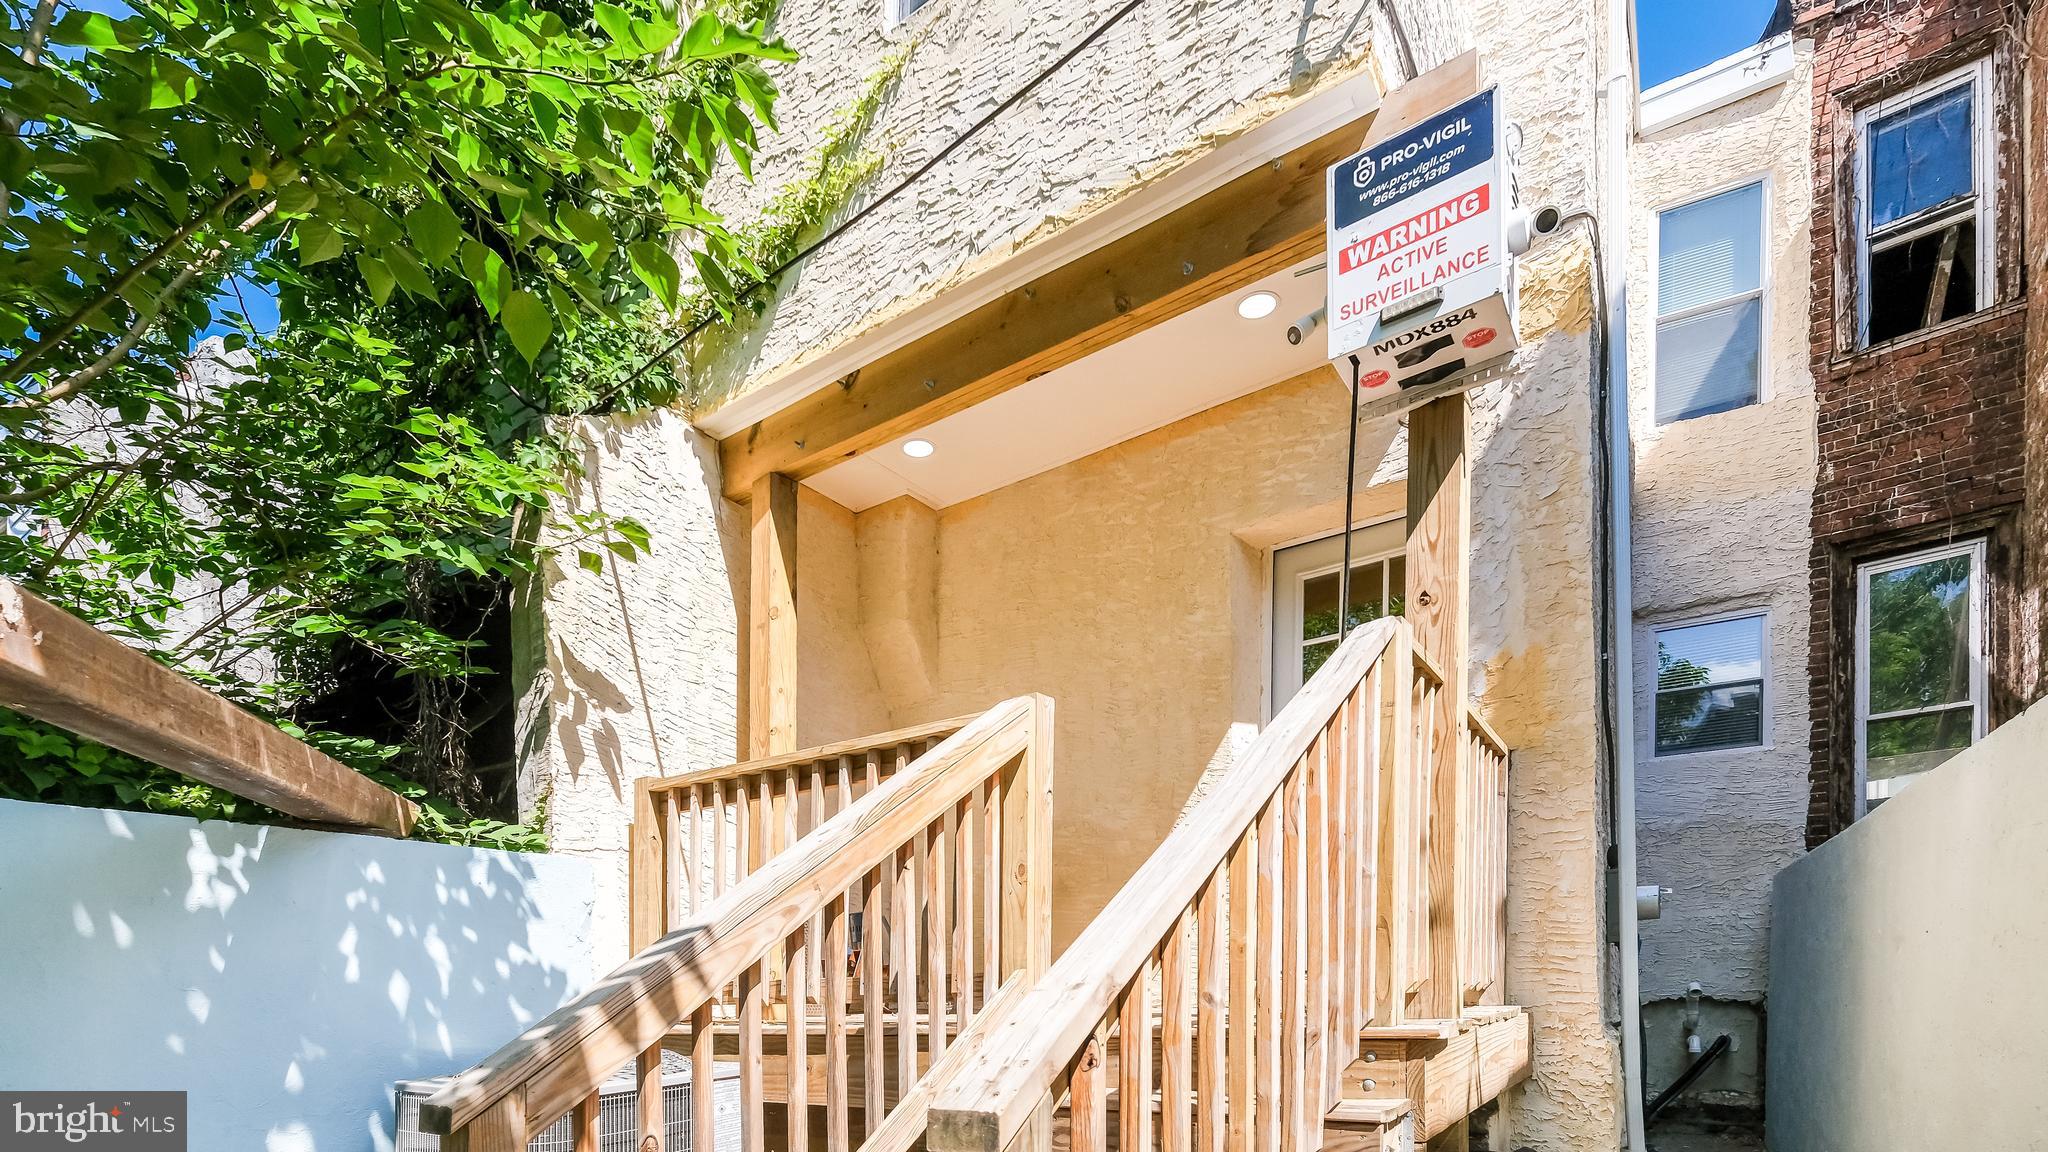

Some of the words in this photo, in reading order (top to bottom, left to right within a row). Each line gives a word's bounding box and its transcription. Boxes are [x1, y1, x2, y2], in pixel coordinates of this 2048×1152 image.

[1381, 117, 1472, 172] PRO-VIGIL
[1359, 144, 1466, 202] www.pro-vigil.com
[1372, 162, 1451, 207] 866-616-1318
[1348, 192, 1480, 269] WARNING
[1340, 244, 1490, 321] SURVEILLANCE
[1377, 236, 1448, 282] ACTIVE
[1373, 308, 1478, 357] MDX884
